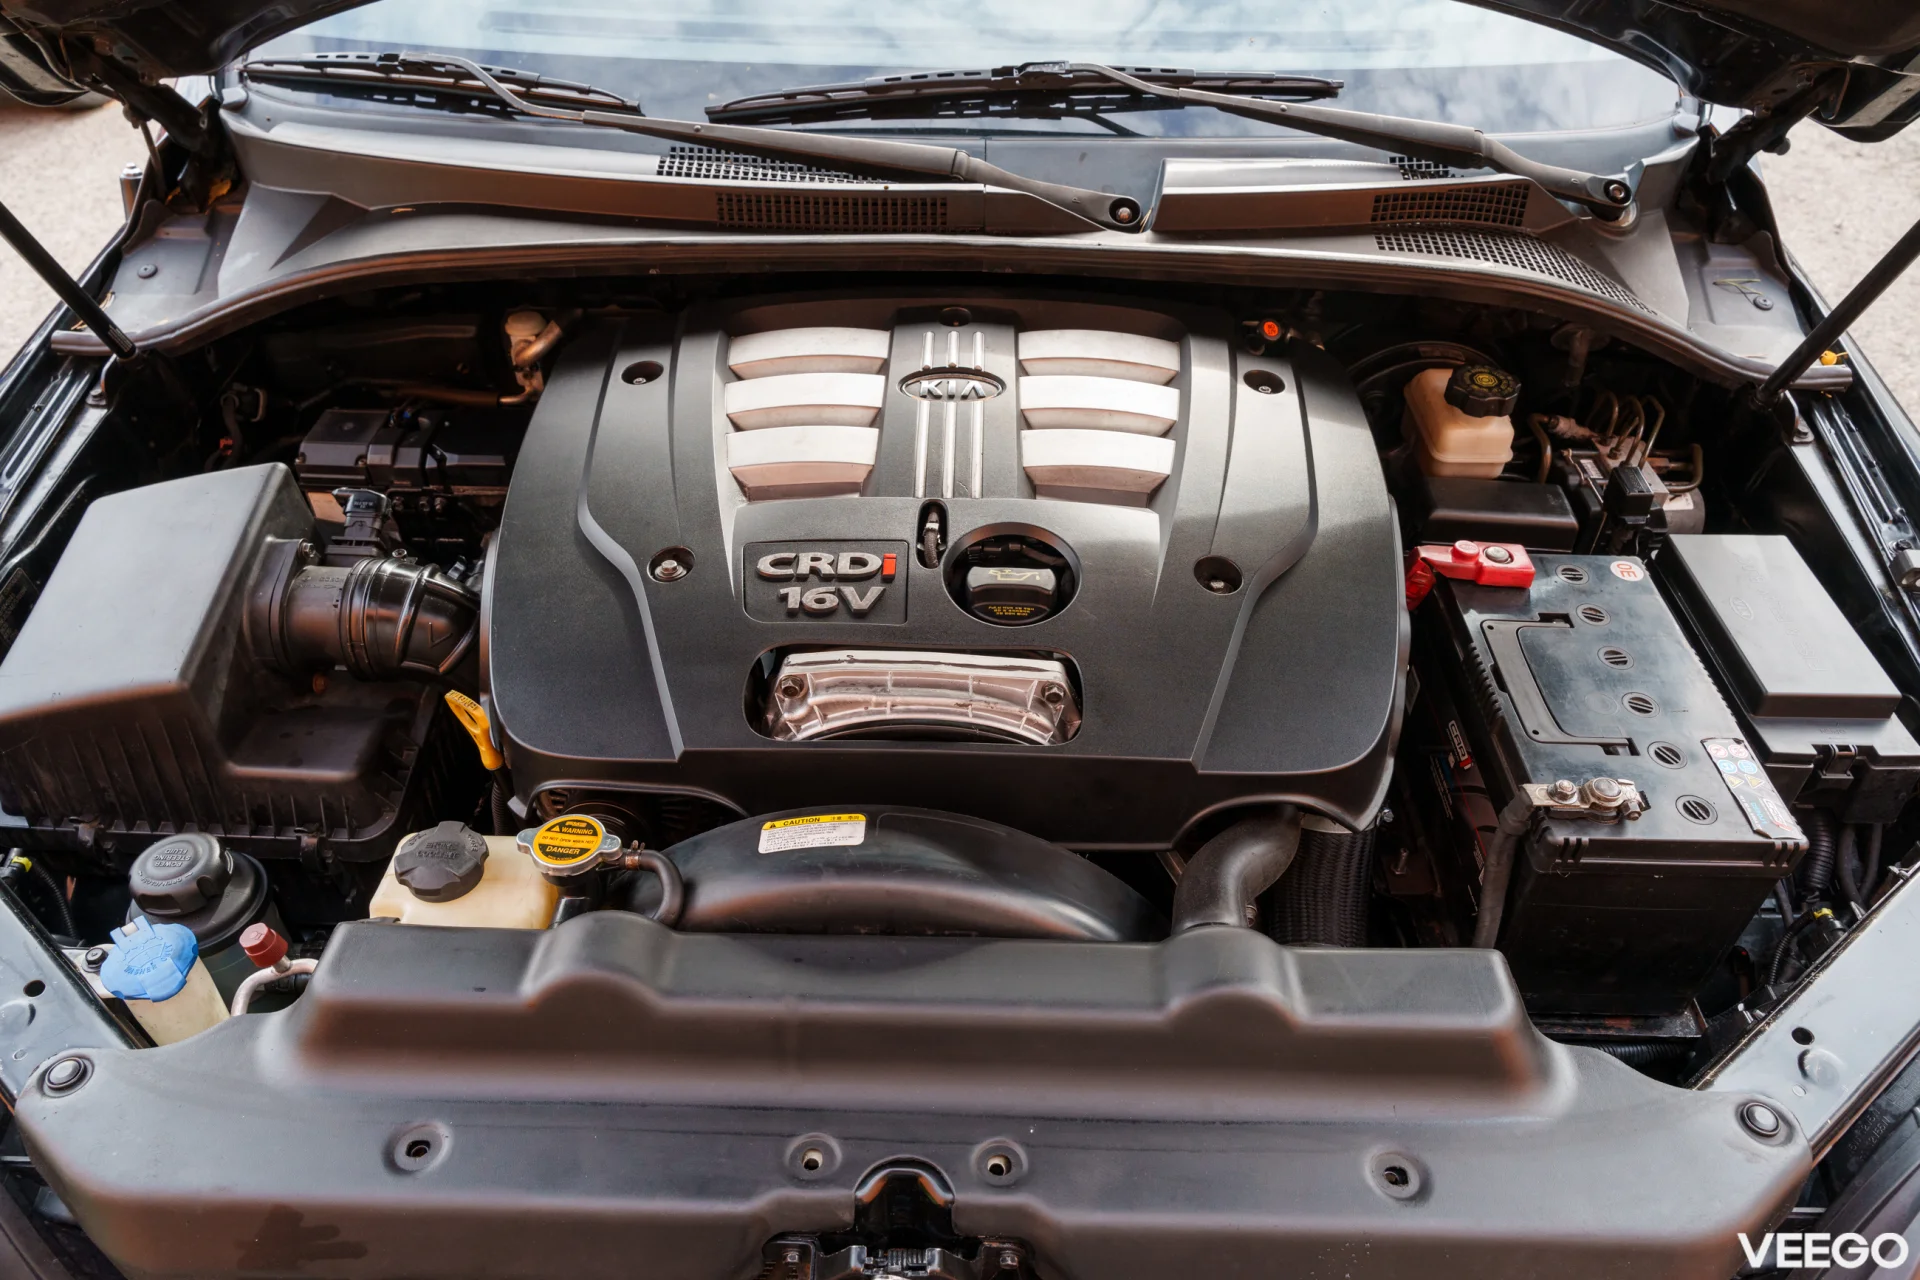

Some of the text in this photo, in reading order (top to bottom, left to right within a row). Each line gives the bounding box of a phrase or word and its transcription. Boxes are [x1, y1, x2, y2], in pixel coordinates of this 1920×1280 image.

[920, 380, 986, 399] KIA
[757, 551, 897, 581] CRDi
[1616, 563, 1638, 578] OE
[779, 586, 886, 612] 16V
[783, 817, 821, 826] CAUTION
[561, 826, 594, 835] WARNING
[546, 845, 580, 855] DANGER
